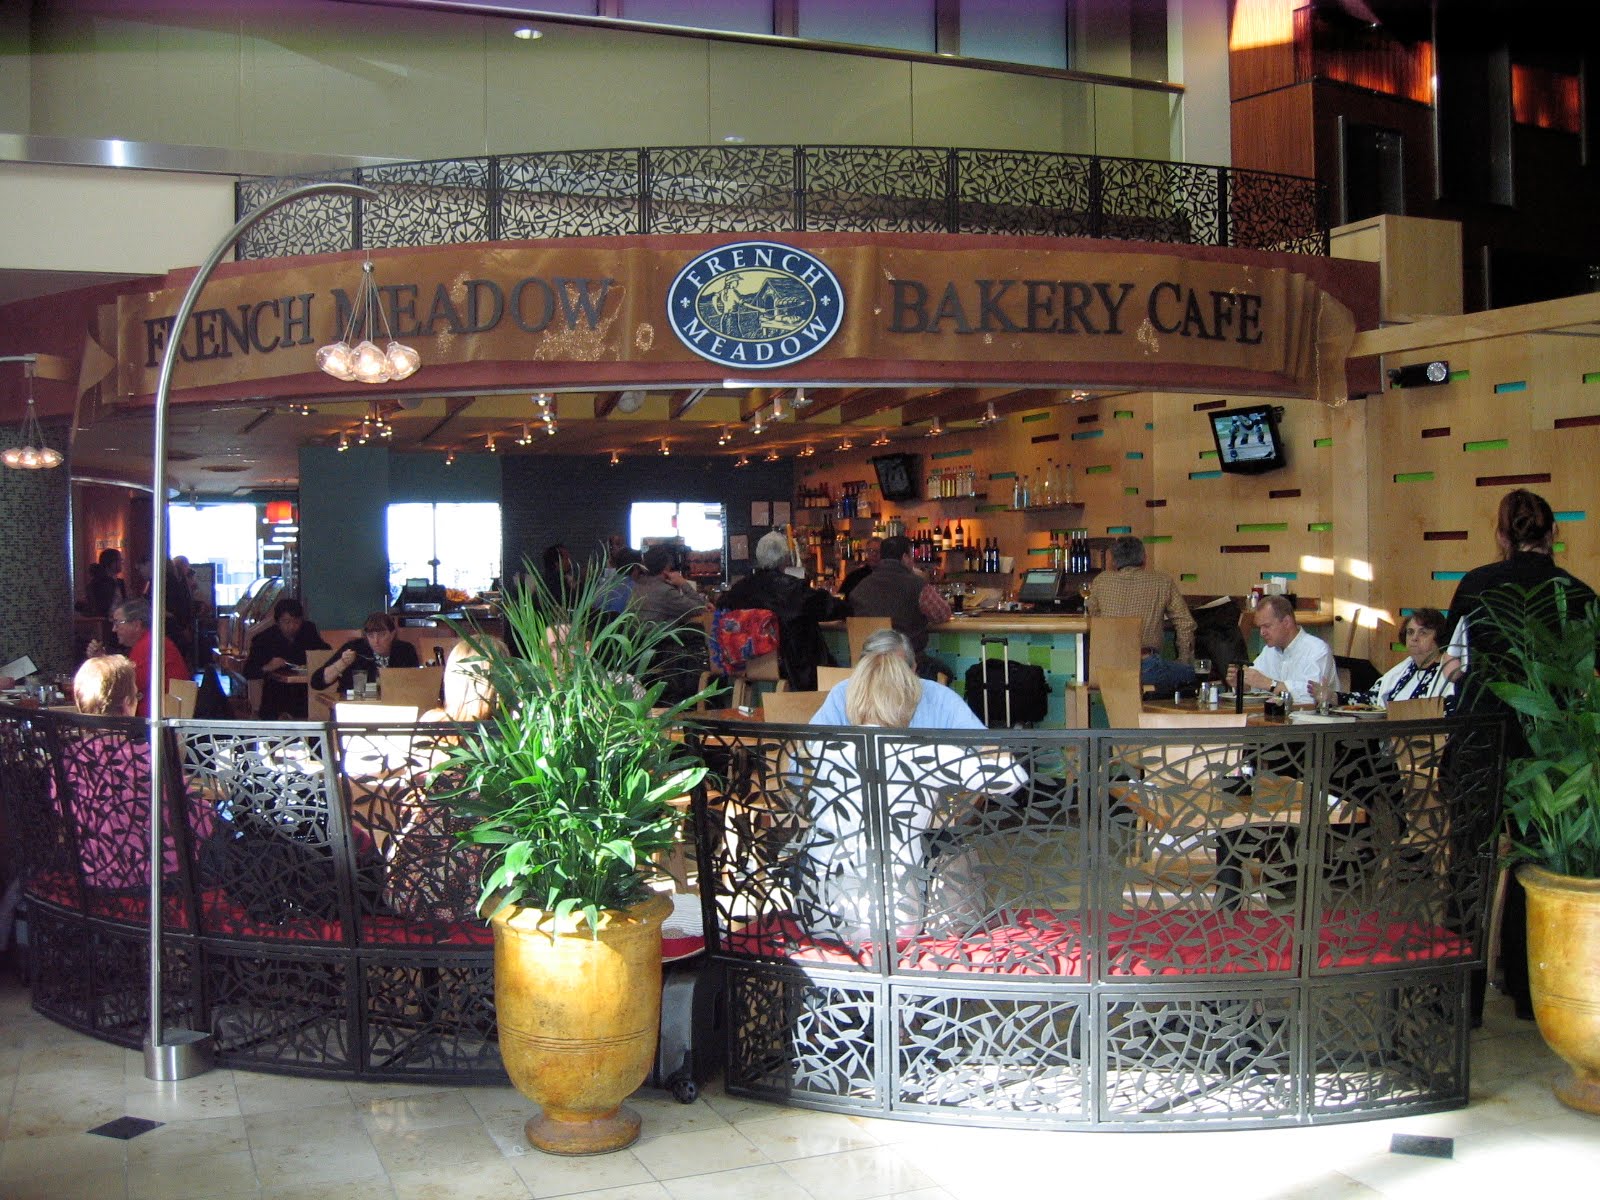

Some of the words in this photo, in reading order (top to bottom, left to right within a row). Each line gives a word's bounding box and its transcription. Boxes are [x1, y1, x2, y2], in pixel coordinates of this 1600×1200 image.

[686, 248, 825, 290] FRENCH
[329, 276, 614, 341] MEADOW
[887, 278, 1135, 335] BAKERY
[1147, 280, 1264, 345] CAFE
[682, 315, 828, 361] MEADOW
